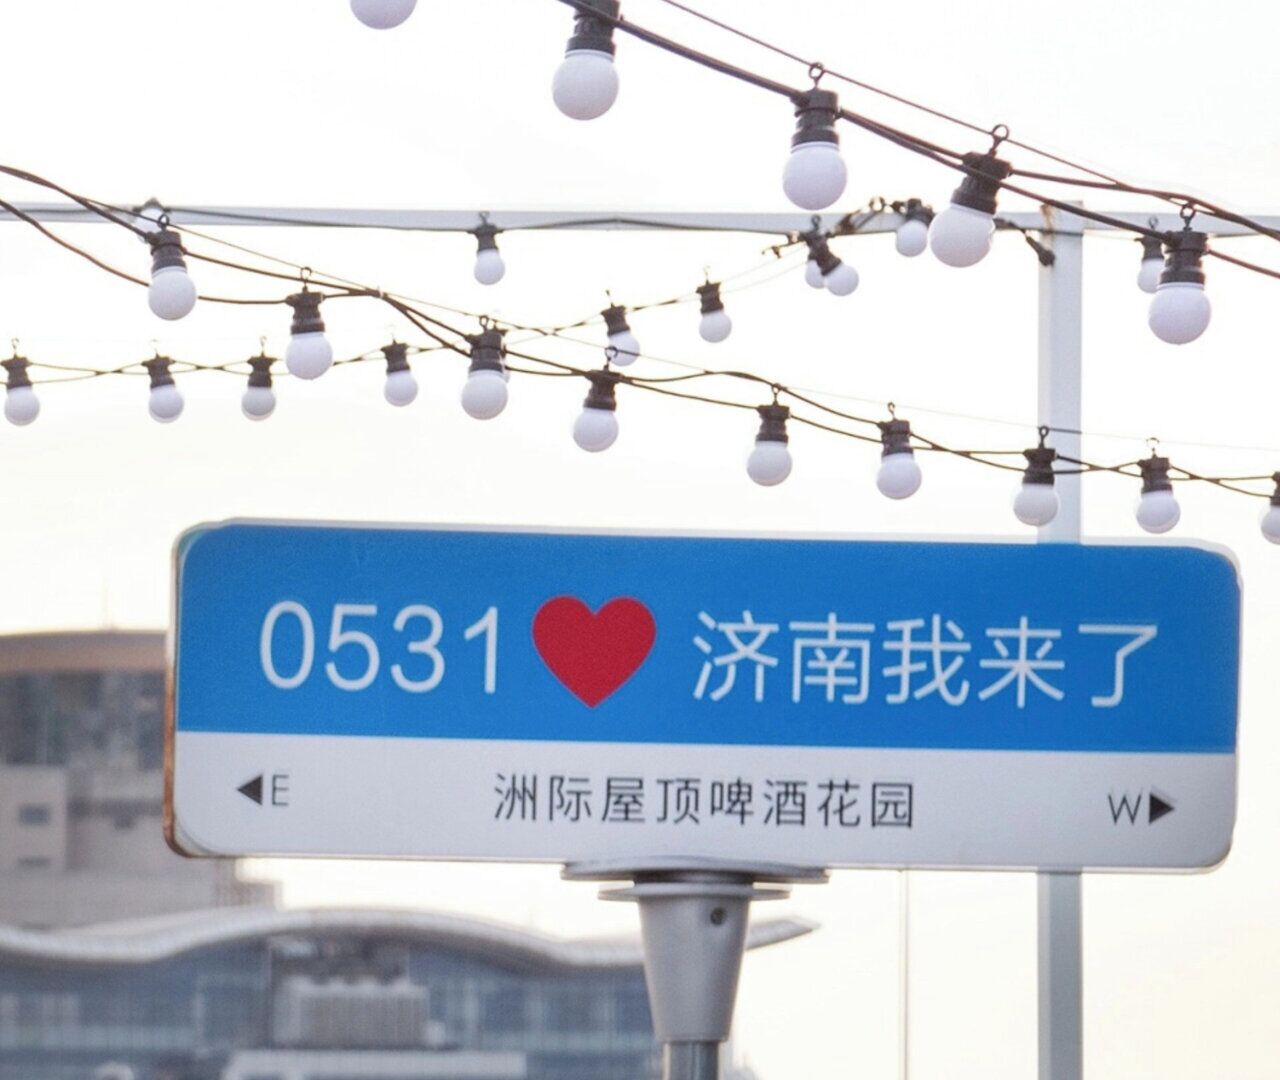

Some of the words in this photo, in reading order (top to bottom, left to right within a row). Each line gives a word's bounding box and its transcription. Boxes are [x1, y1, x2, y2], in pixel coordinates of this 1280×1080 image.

[260, 599, 499, 694] 0531
[692, 609, 1158, 709] 济南我来了
[271, 774, 290, 806] E
[493, 772, 915, 829] 洲际屋顶啤酒花园
[1107, 793, 1143, 826] W
